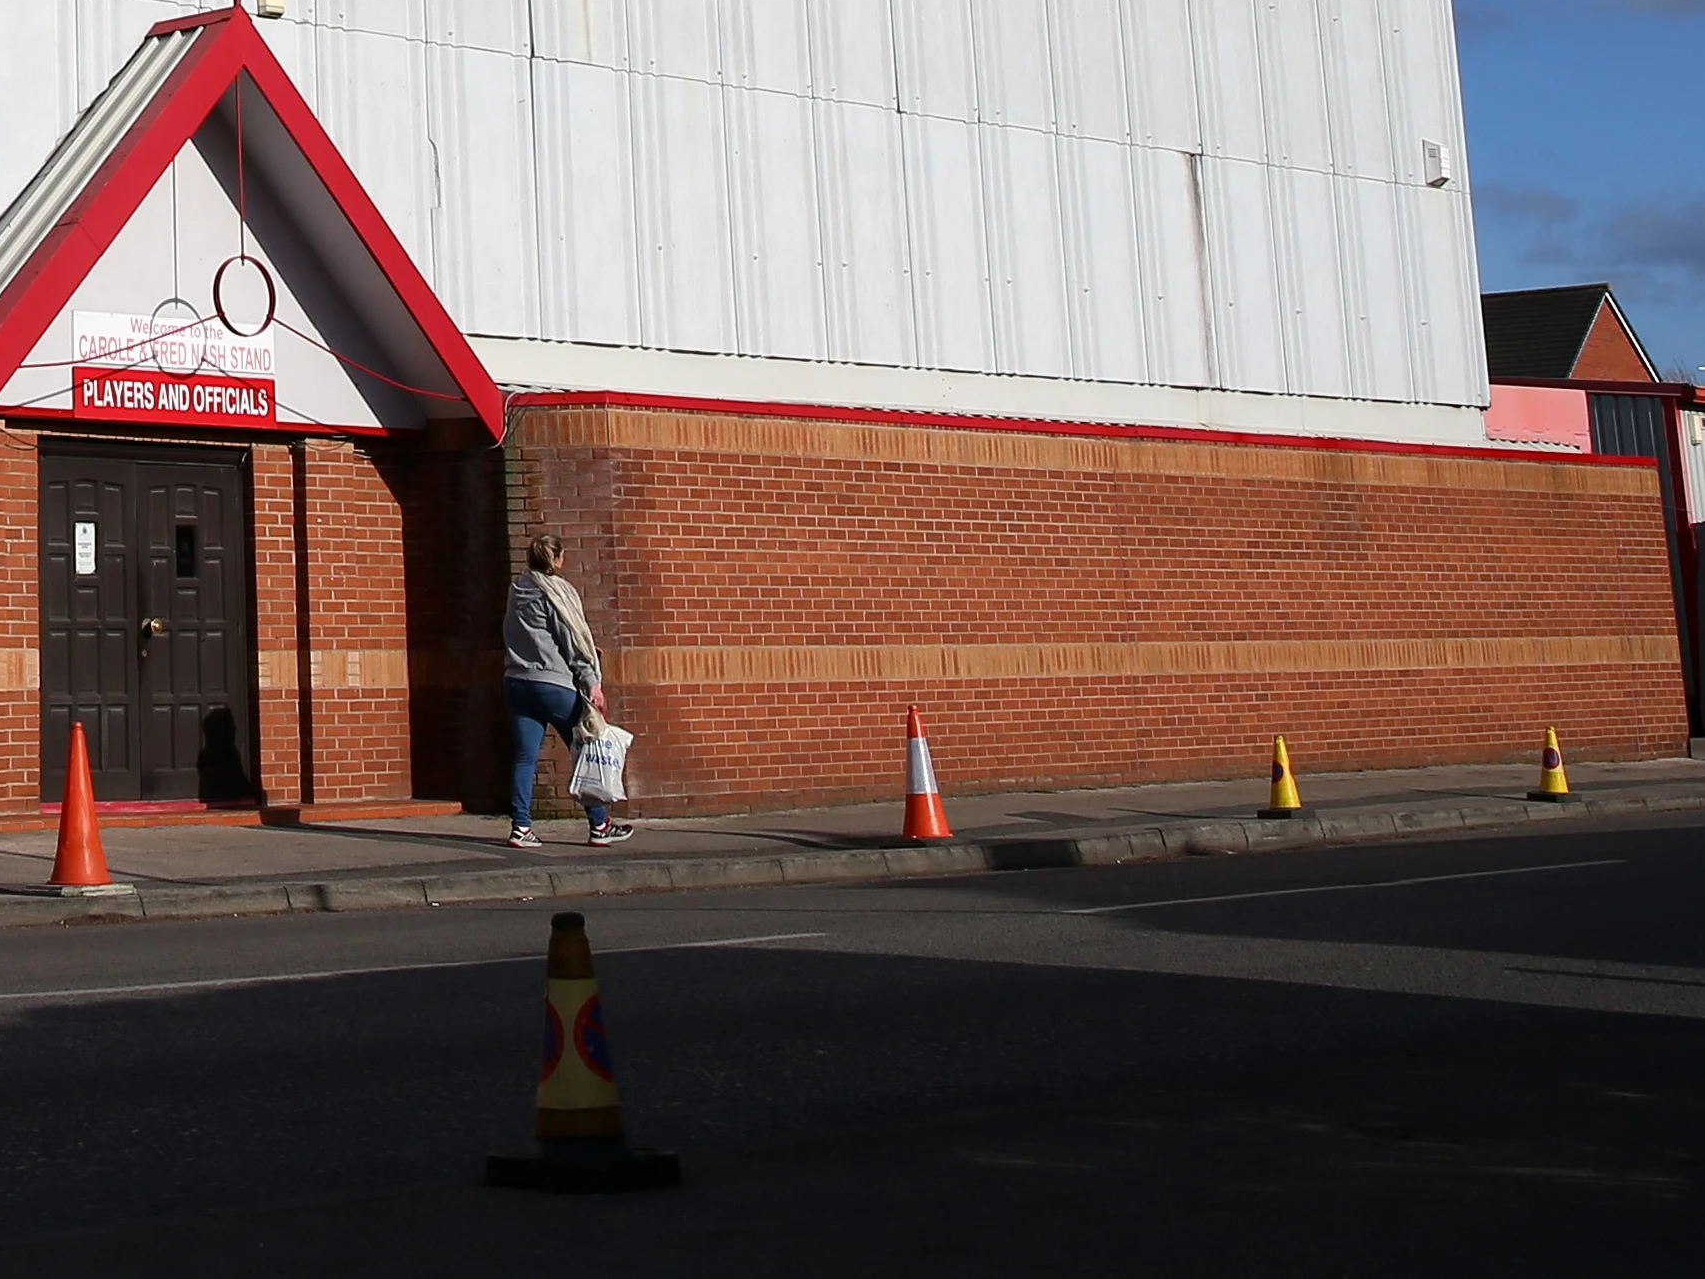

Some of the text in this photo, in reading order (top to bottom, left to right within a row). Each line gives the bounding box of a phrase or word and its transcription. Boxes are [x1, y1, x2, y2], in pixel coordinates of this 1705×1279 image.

[130, 317, 223, 340] Welcome to the
[79, 334, 135, 362] CAROLE
[153, 340, 187, 366] FRED
[191, 343, 226, 369] NASH
[230, 346, 271, 372] STAND
[84, 379, 268, 416] PLAYERS AND OFFICIALS
